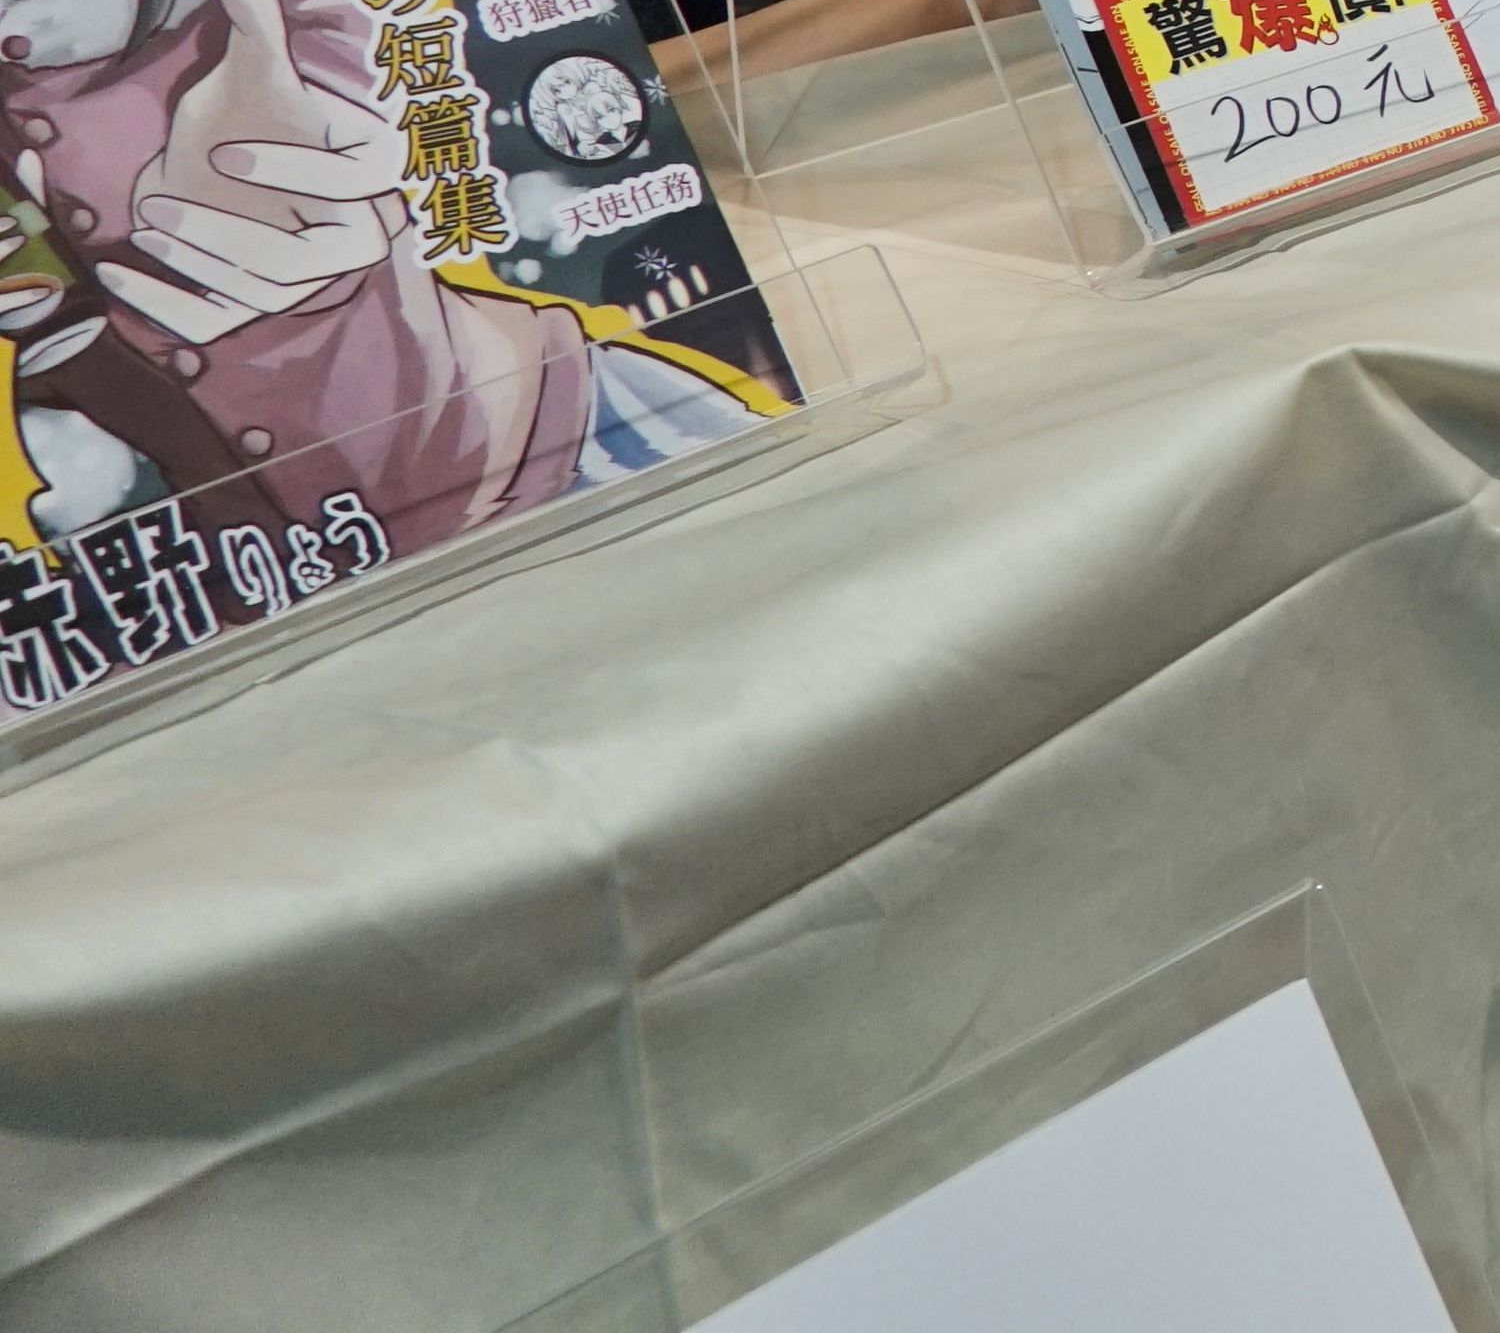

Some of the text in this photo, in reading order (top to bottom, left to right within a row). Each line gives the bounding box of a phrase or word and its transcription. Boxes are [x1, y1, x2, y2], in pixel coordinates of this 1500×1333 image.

[1108, 4, 1124, 25] ON
[1118, 27, 1137, 56] SALE
[1448, 32, 1466, 60] SALE
[1130, 54, 1146, 76] ON
[1140, 78, 1159, 108] SALE
[1210, 44, 1436, 163] 200元
[1163, 127, 1183, 157] SALE
[559, 168, 698, 234] 天使任務
